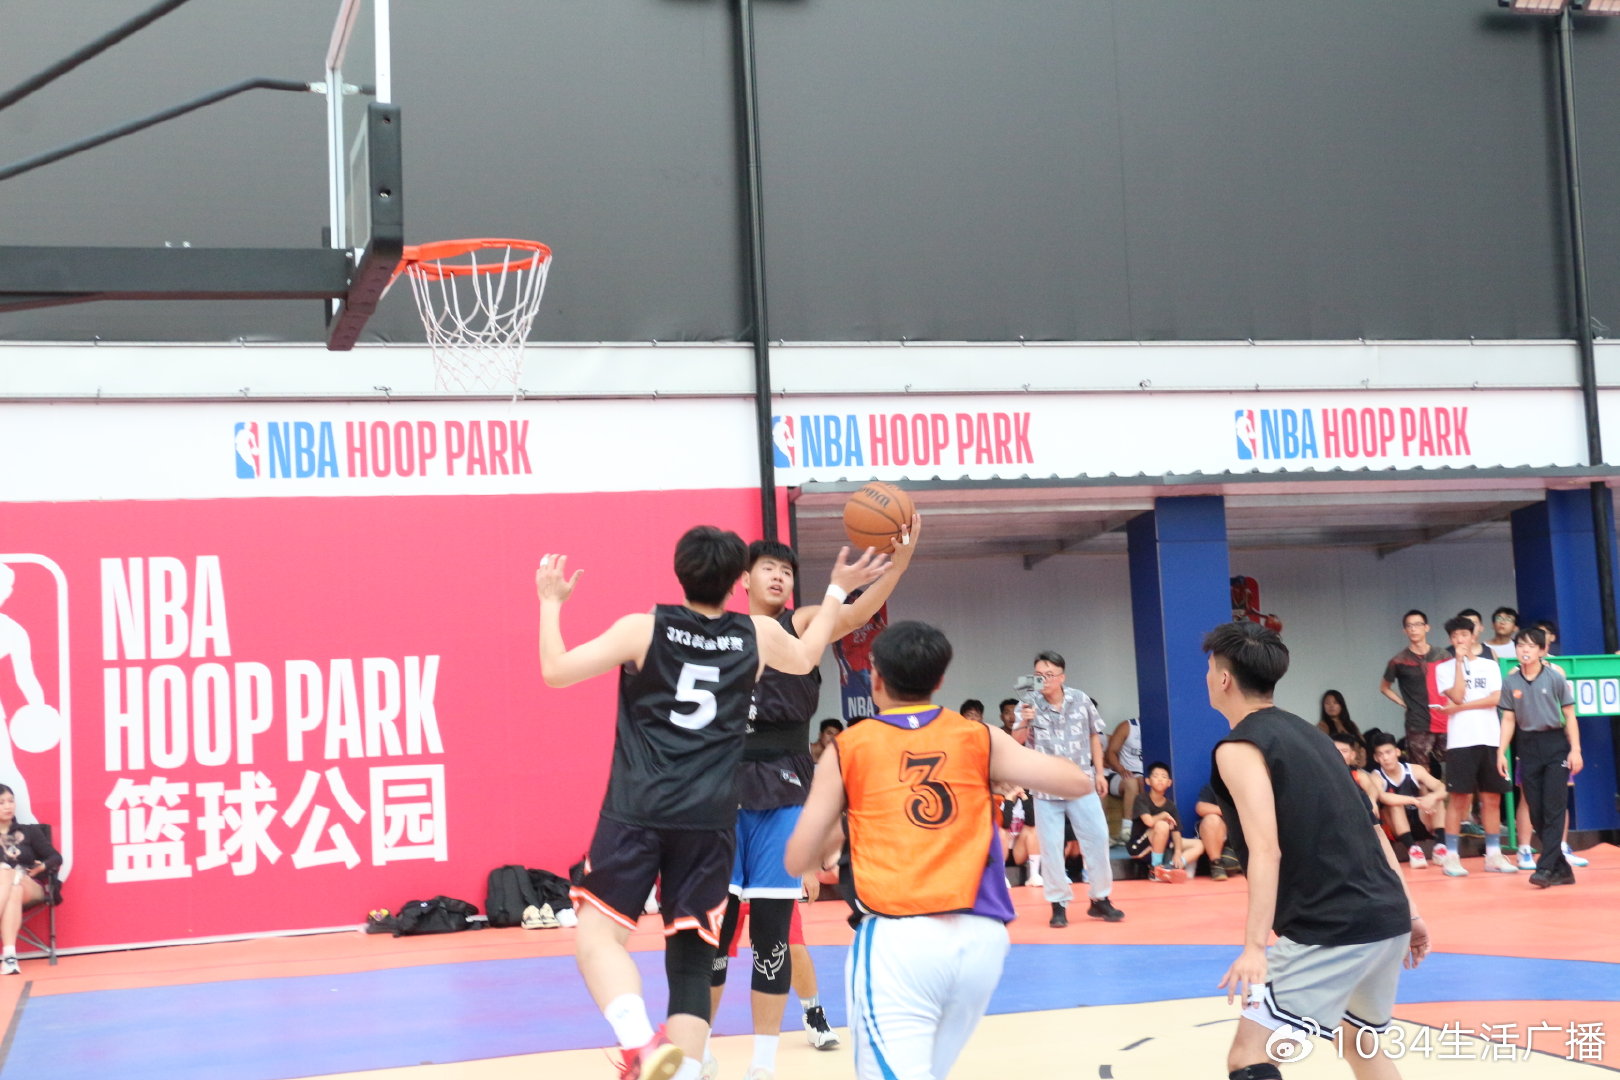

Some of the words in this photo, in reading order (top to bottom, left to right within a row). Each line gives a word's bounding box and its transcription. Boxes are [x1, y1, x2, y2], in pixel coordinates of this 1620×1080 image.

[267, 421, 340, 479] NBA
[346, 420, 437, 478] HOOP
[444, 419, 532, 476] PARK
[800, 414, 864, 468] NBA
[869, 413, 950, 466] HOOP
[955, 412, 1034, 465] PARK
[1259, 408, 1319, 460] NBA
[1321, 407, 1396, 459] HOOP
[1399, 406, 1471, 457] PARK
[100, 554, 232, 661] NBA
[103, 661, 274, 772] HOOP
[284, 654, 445, 762] PARK
[668, 662, 721, 729] 5
[847, 696, 875, 718] NBA
[104, 763, 449, 884] 篮球公园
[898, 750, 959, 830] 3
